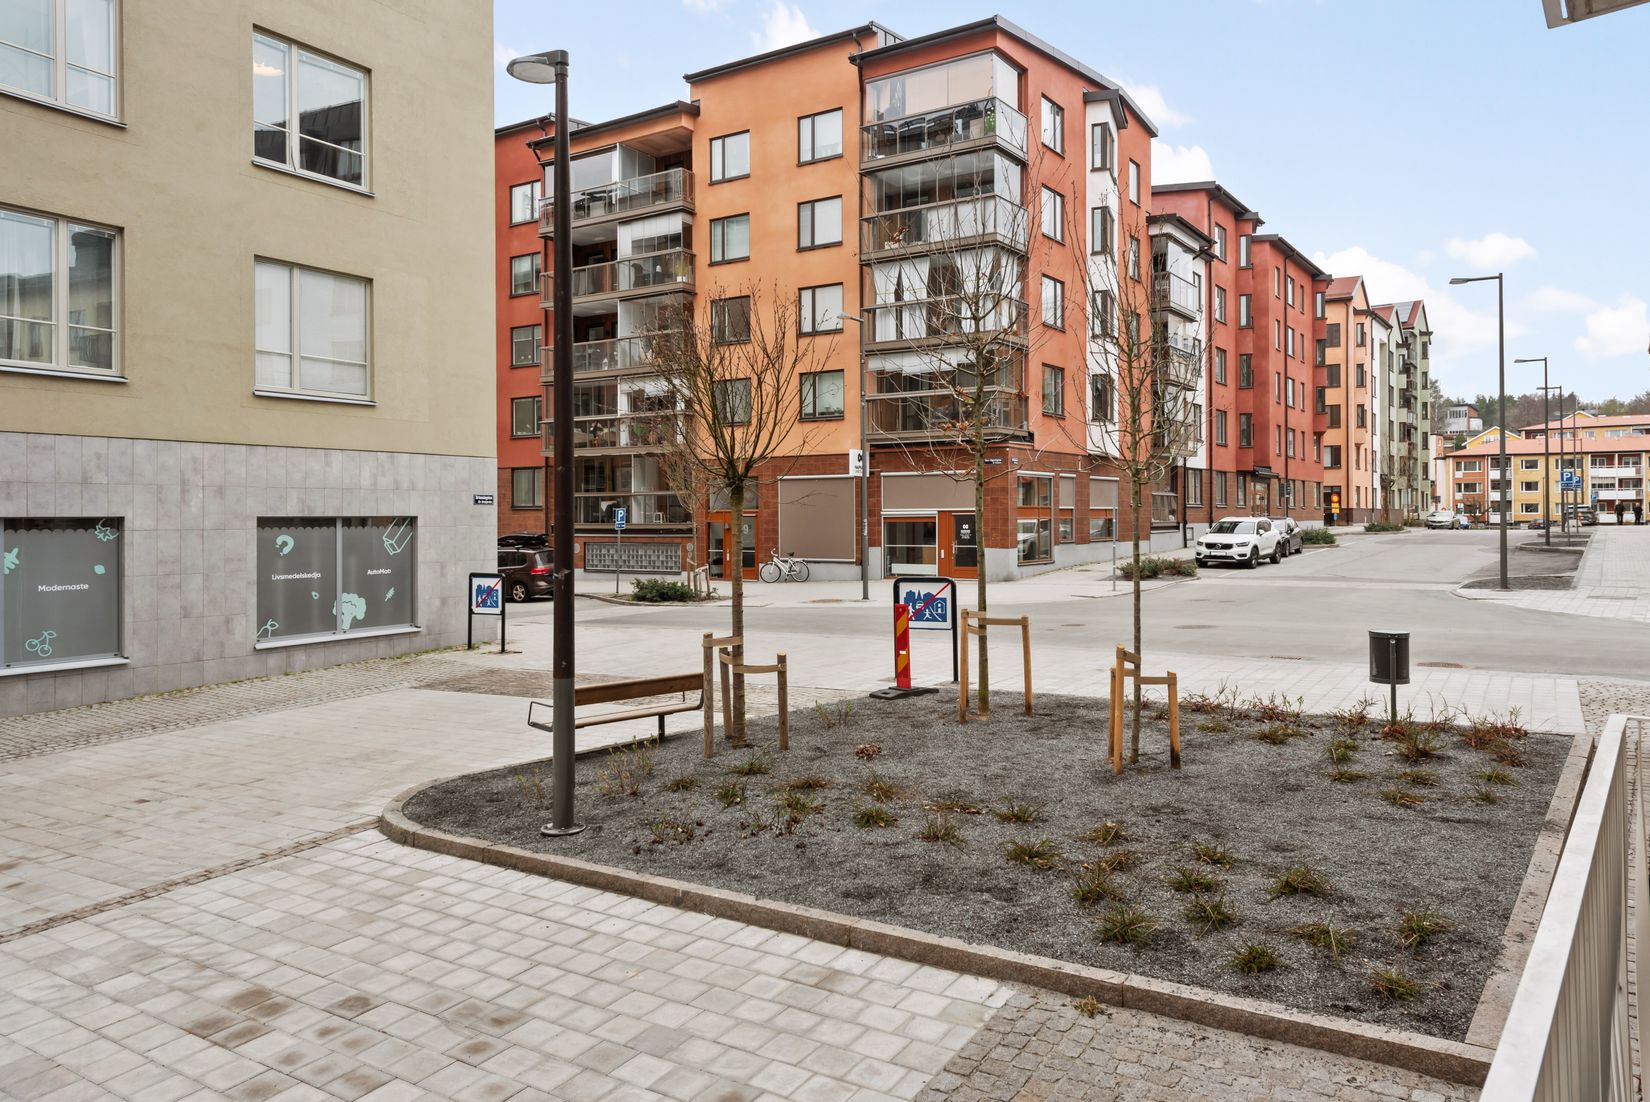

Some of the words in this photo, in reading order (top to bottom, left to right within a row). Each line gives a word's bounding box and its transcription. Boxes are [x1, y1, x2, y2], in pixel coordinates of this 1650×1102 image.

[1563, 472, 1571, 482] P
[618, 510, 624, 521] P
[38, 583, 89, 592] Modernaste
